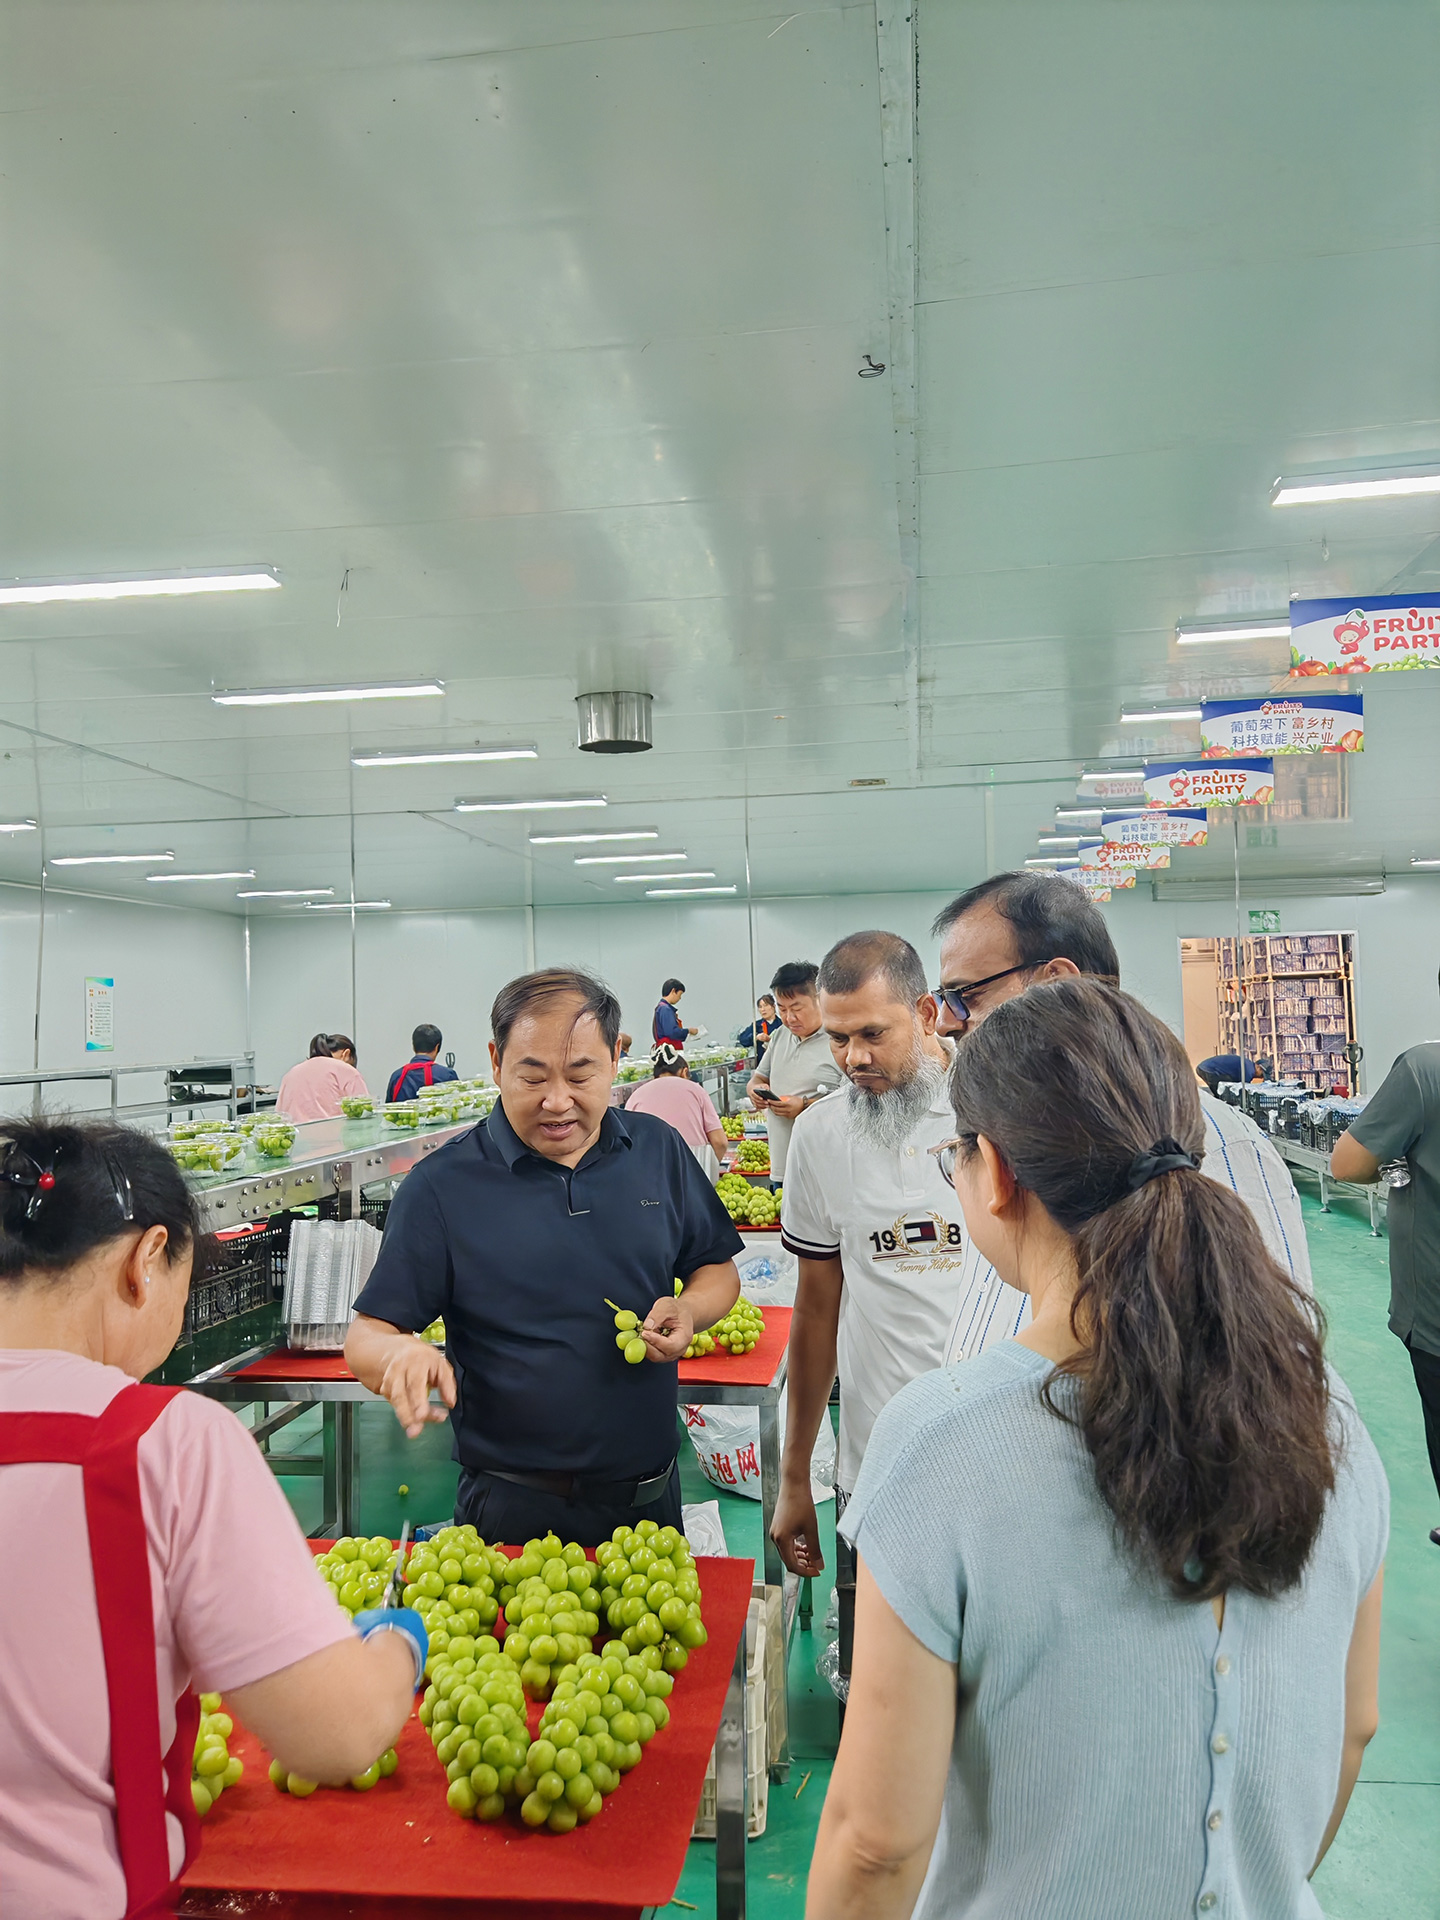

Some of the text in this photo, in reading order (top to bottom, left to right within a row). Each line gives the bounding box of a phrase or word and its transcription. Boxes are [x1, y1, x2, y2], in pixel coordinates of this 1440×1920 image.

[1230, 717, 1335, 733] 葡萄架下 富乡村
[1232, 732, 1334, 747] 科技赋能 兴产业
[1192, 770, 1247, 784] FRUITS
[1193, 785, 1245, 796] PARTY
[1161, 822, 1188, 831] 富乡村
[1161, 832, 1188, 840] 兴产业
[1113, 854, 1150, 862] PARTY
[869, 1230, 897, 1252] 19
[894, 1261, 927, 1274] Tommy
